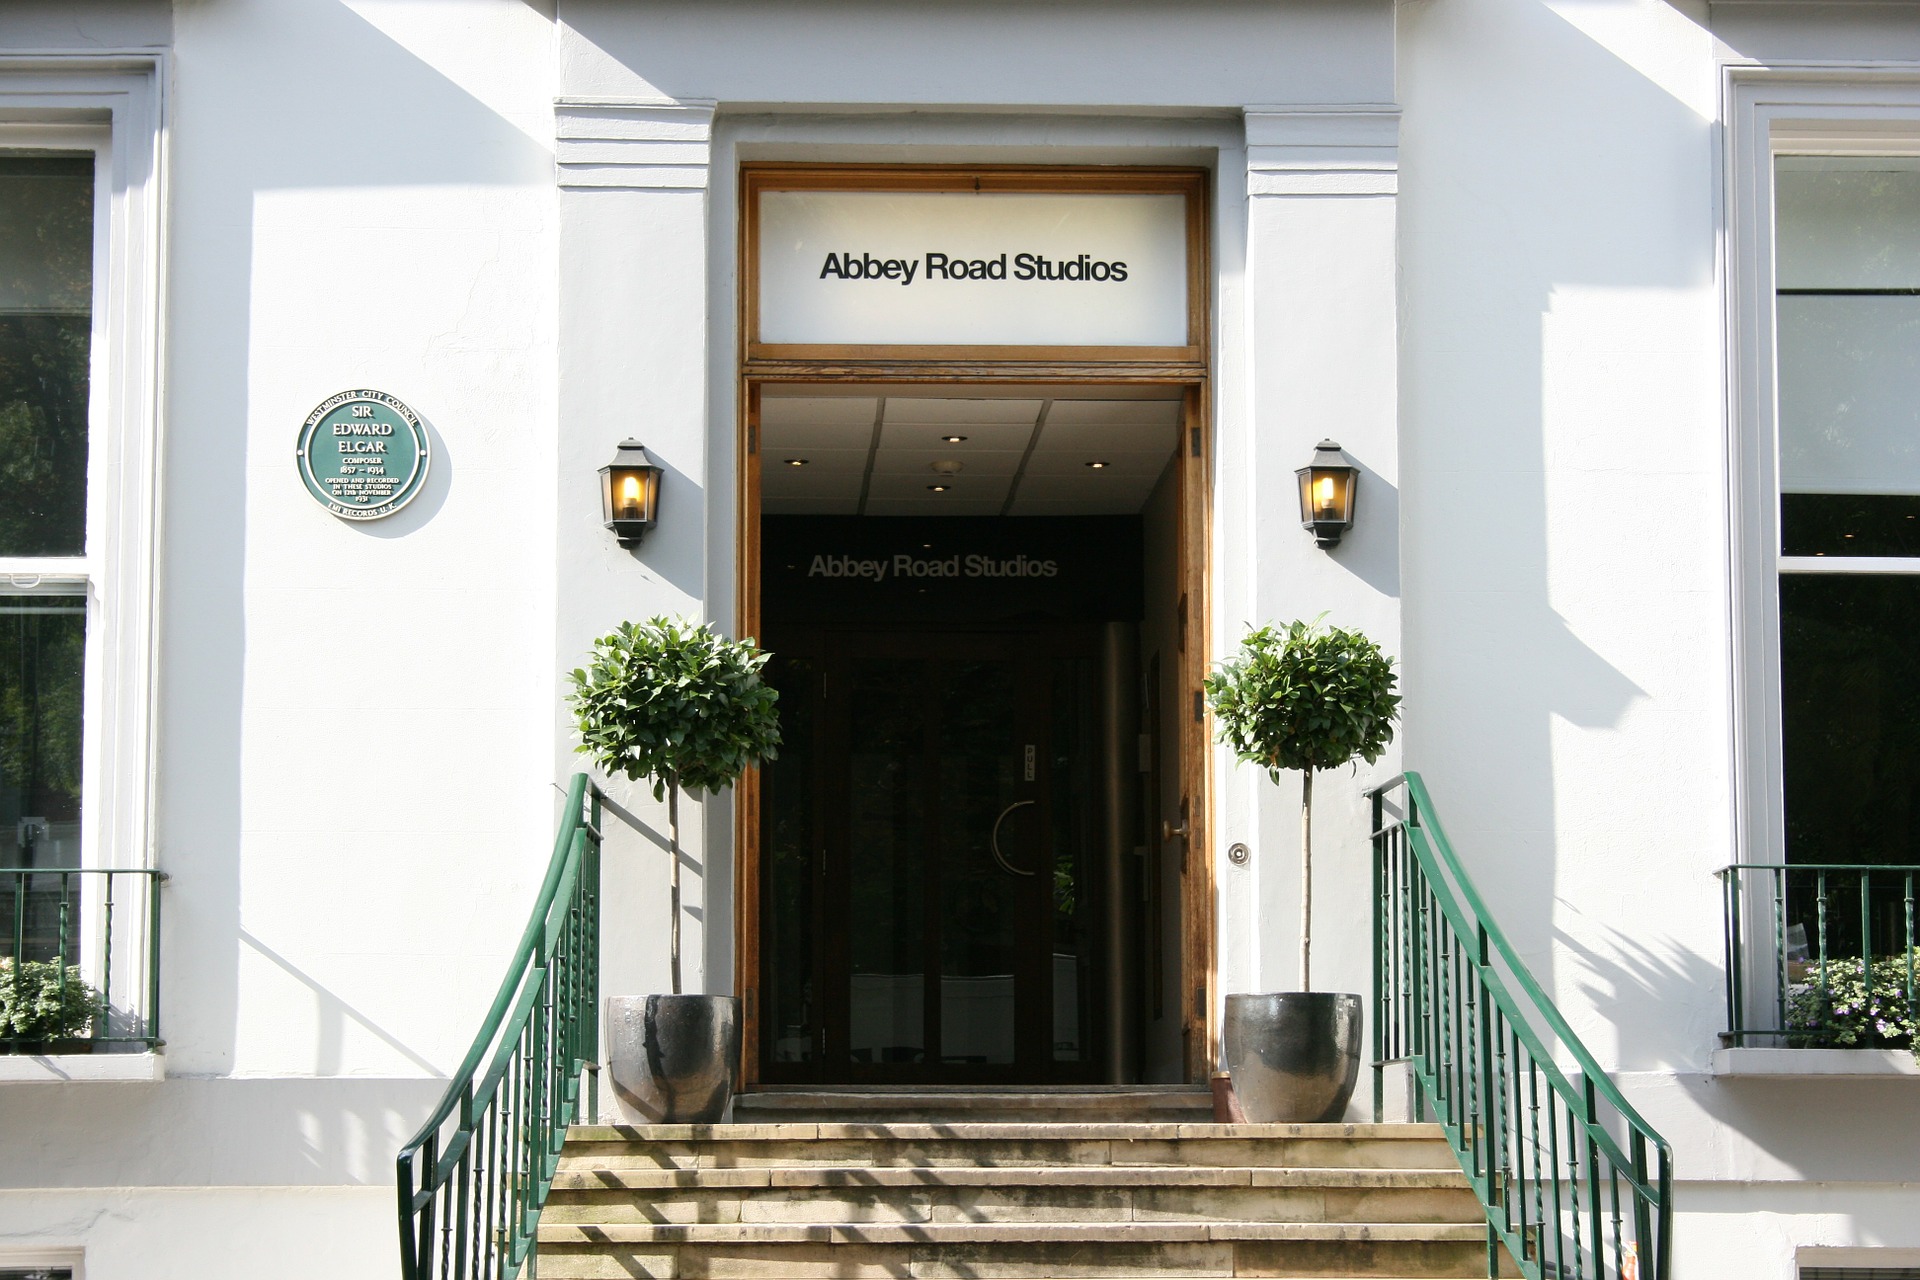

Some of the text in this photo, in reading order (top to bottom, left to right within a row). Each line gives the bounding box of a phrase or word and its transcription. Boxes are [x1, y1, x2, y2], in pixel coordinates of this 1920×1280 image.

[819, 252, 1128, 286] Abbey Road Studios
[306, 390, 418, 427] WESTMINSTER CITY COUNCIL
[352, 406, 373, 417] SIR
[333, 423, 392, 435] EDWARD
[338, 441, 386, 453] ELGAR
[340, 466, 356, 475] 1857
[367, 466, 384, 475] 1934
[328, 502, 341, 513] EMI
[342, 509, 378, 517] RECORDS
[808, 554, 1058, 583] Abbey Road Studios
[1026, 746, 1034, 779] PULL
